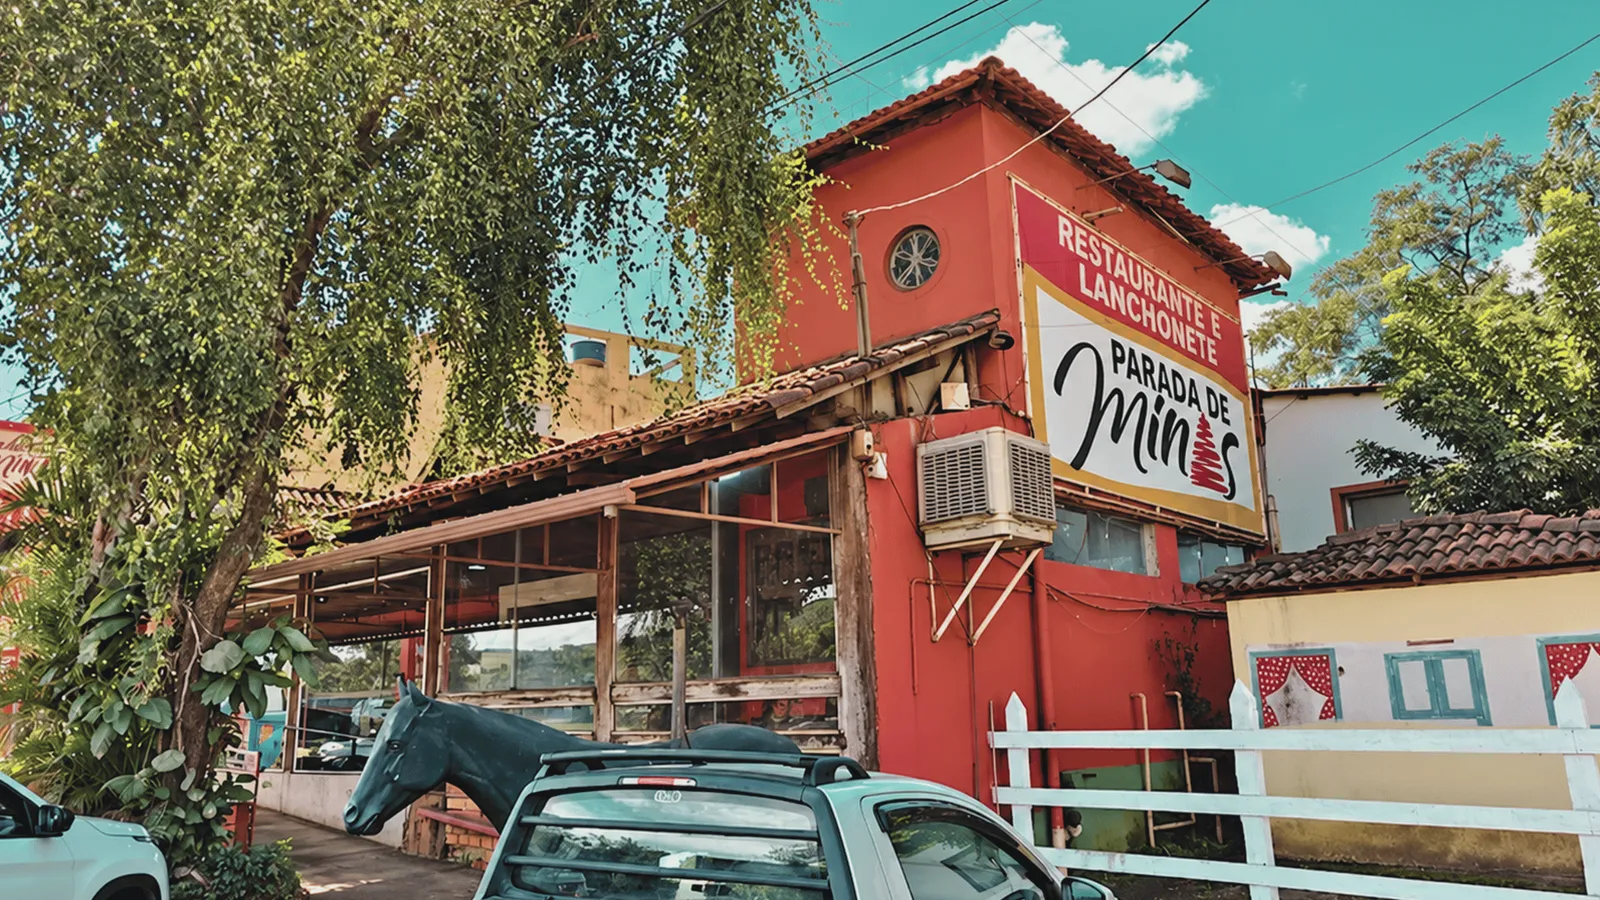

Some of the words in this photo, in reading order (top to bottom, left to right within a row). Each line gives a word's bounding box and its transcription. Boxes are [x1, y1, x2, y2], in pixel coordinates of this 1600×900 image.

[1058, 215, 1205, 330] RESTAURANTE
[1211, 311, 1222, 340] E
[1079, 263, 1218, 366] LANCHONETE
[1111, 338, 1202, 412] PARADA
[1206, 386, 1231, 426] DE
